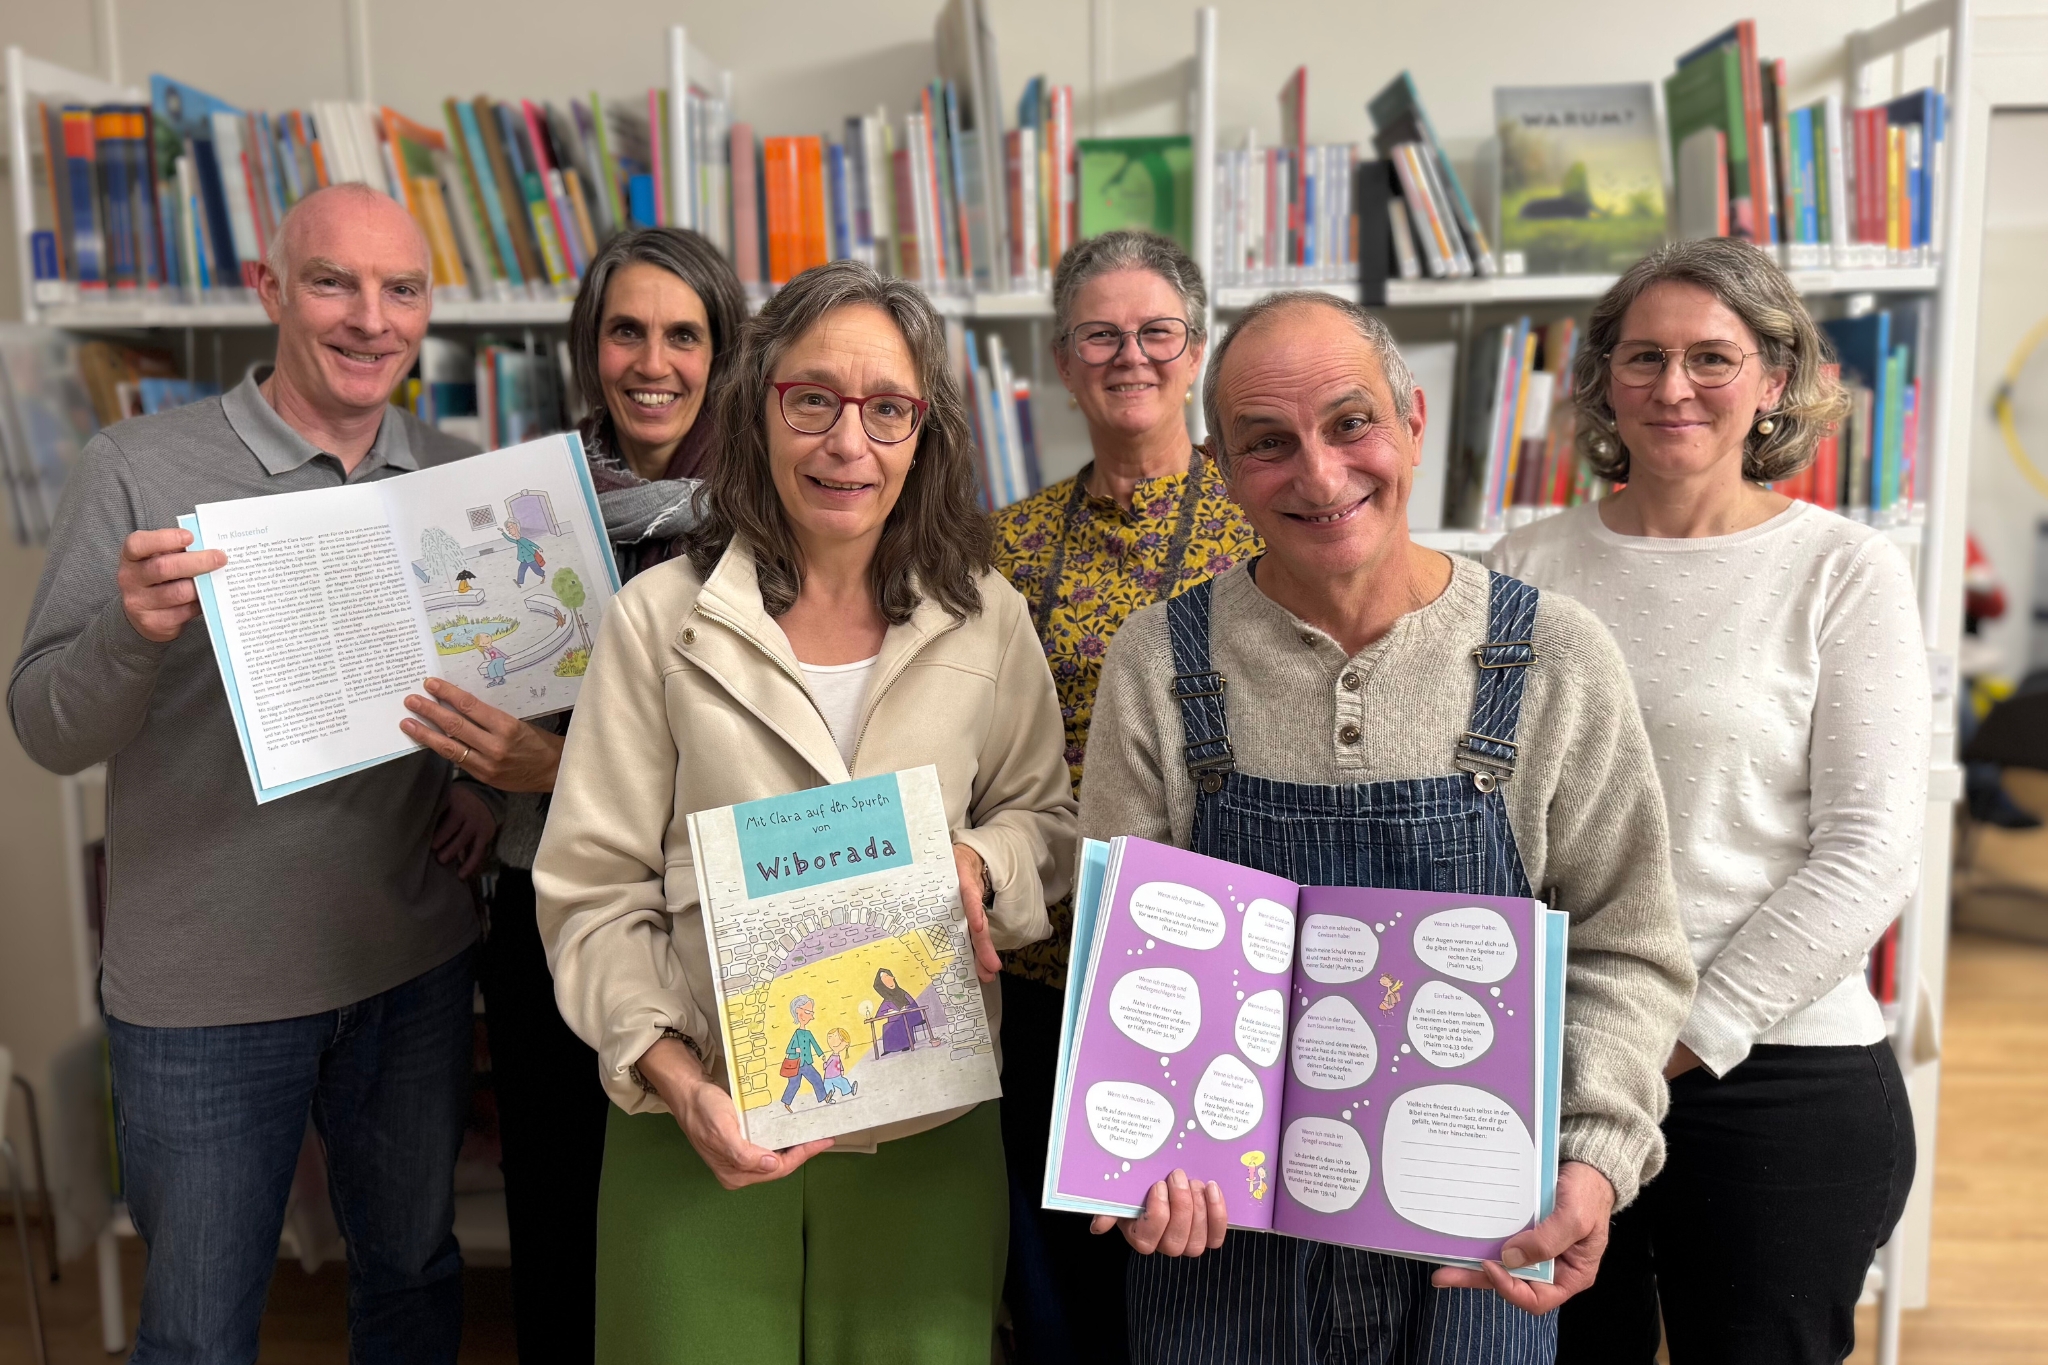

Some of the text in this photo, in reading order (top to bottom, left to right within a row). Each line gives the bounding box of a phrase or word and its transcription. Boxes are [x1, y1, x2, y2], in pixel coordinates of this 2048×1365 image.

[1522, 110, 1634, 128] WARUM?
[230, 526, 269, 538] Klosterhof
[746, 794, 890, 830] Mit Clara auf den Spuren
[812, 823, 831, 833] von
[756, 836, 896, 881] Wiborada
[1158, 890, 1170, 899] Wenn
[1162, 924, 1177, 933] (Psalm
[1451, 1130, 1487, 1139] hinschreiben:
[1302, 1136, 1317, 1144] Spiegel
[1288, 1175, 1312, 1184] Wunderbar
